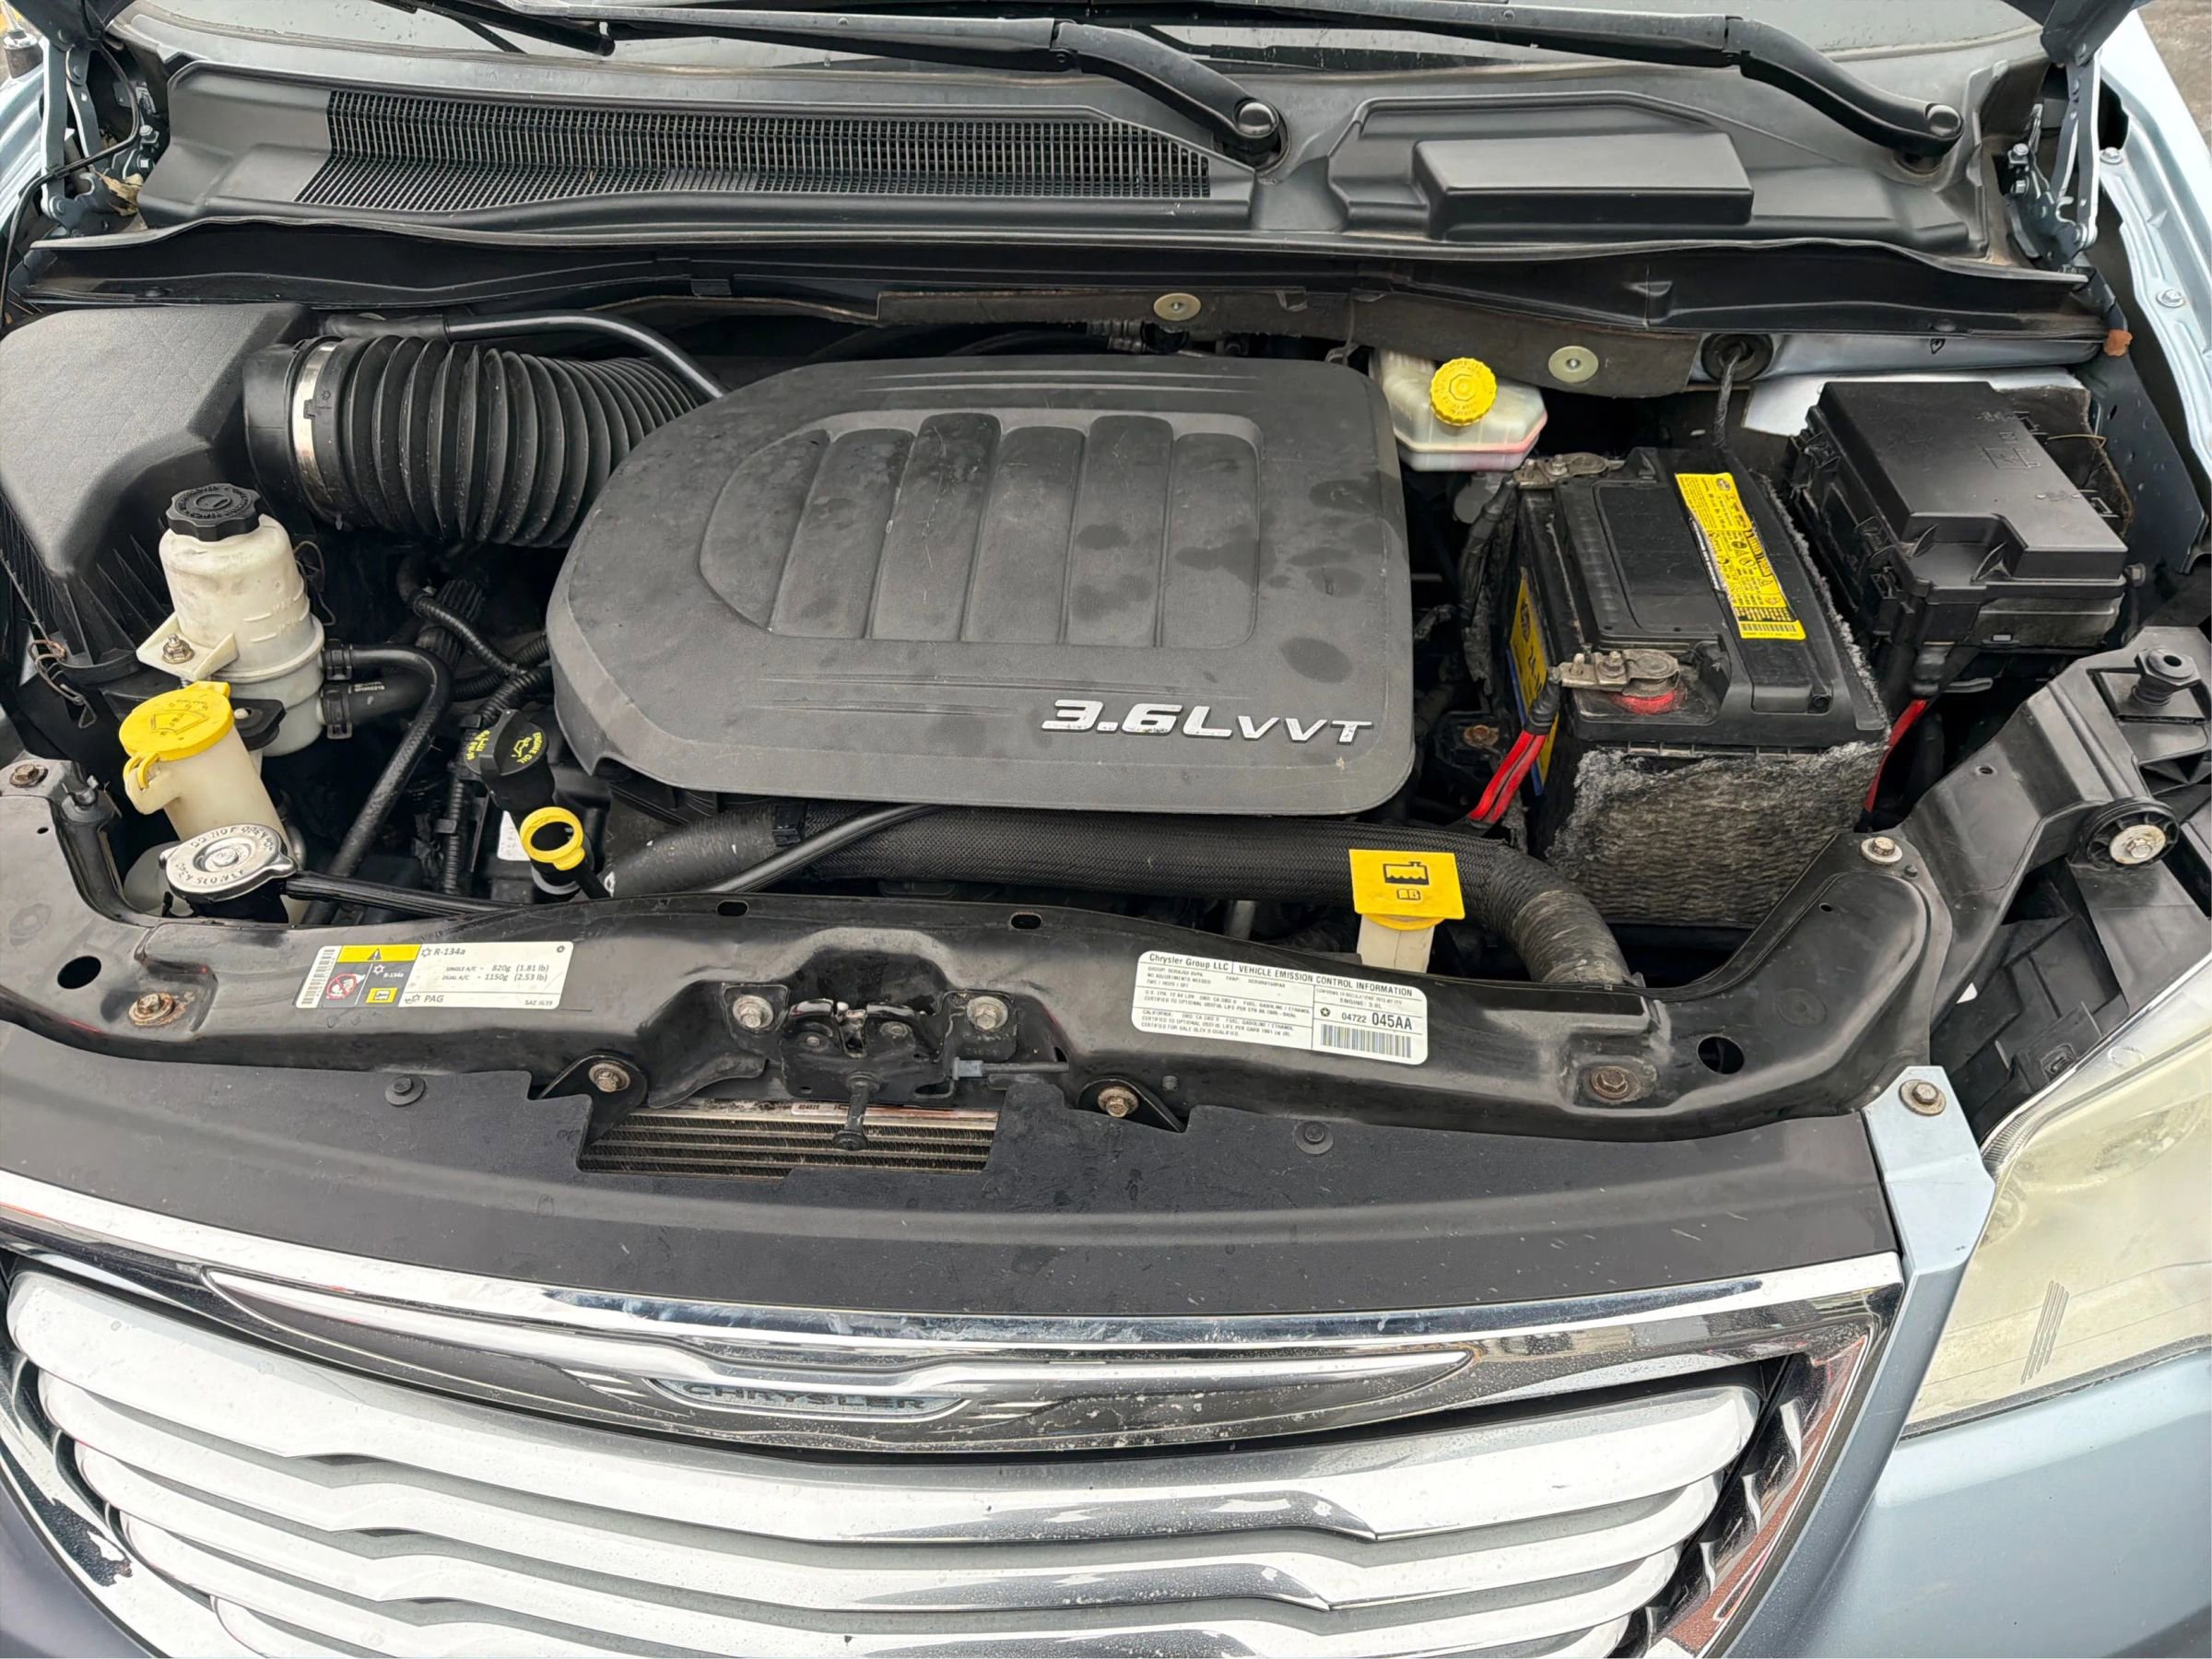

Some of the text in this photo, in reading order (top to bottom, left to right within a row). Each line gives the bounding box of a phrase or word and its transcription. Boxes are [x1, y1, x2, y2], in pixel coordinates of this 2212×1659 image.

[1041, 700, 1373, 744] 3.6L VVT
[433, 947, 466, 957] R-134a
[492, 964, 512, 973] 820g
[516, 964, 537, 973] (1.81
[538, 964, 550, 973] lb)
[1148, 952, 1182, 967] Chrysler
[1185, 957, 1210, 970] Group
[1213, 960, 1229, 971] LLC
[1239, 964, 1271, 976] VEHICLE
[1275, 970, 1312, 982] EMISSION
[1315, 975, 1352, 988] CONTROL
[1356, 981, 1412, 996] INFORMATION
[485, 973, 509, 982] 1150g
[514, 972, 535, 982] (2.53
[536, 972, 548, 982] lb)
[424, 994, 444, 1004] PAG
[1341, 1011, 1412, 1030] 04722 045AA
[682, 1384, 925, 1409] CHRYSLER
